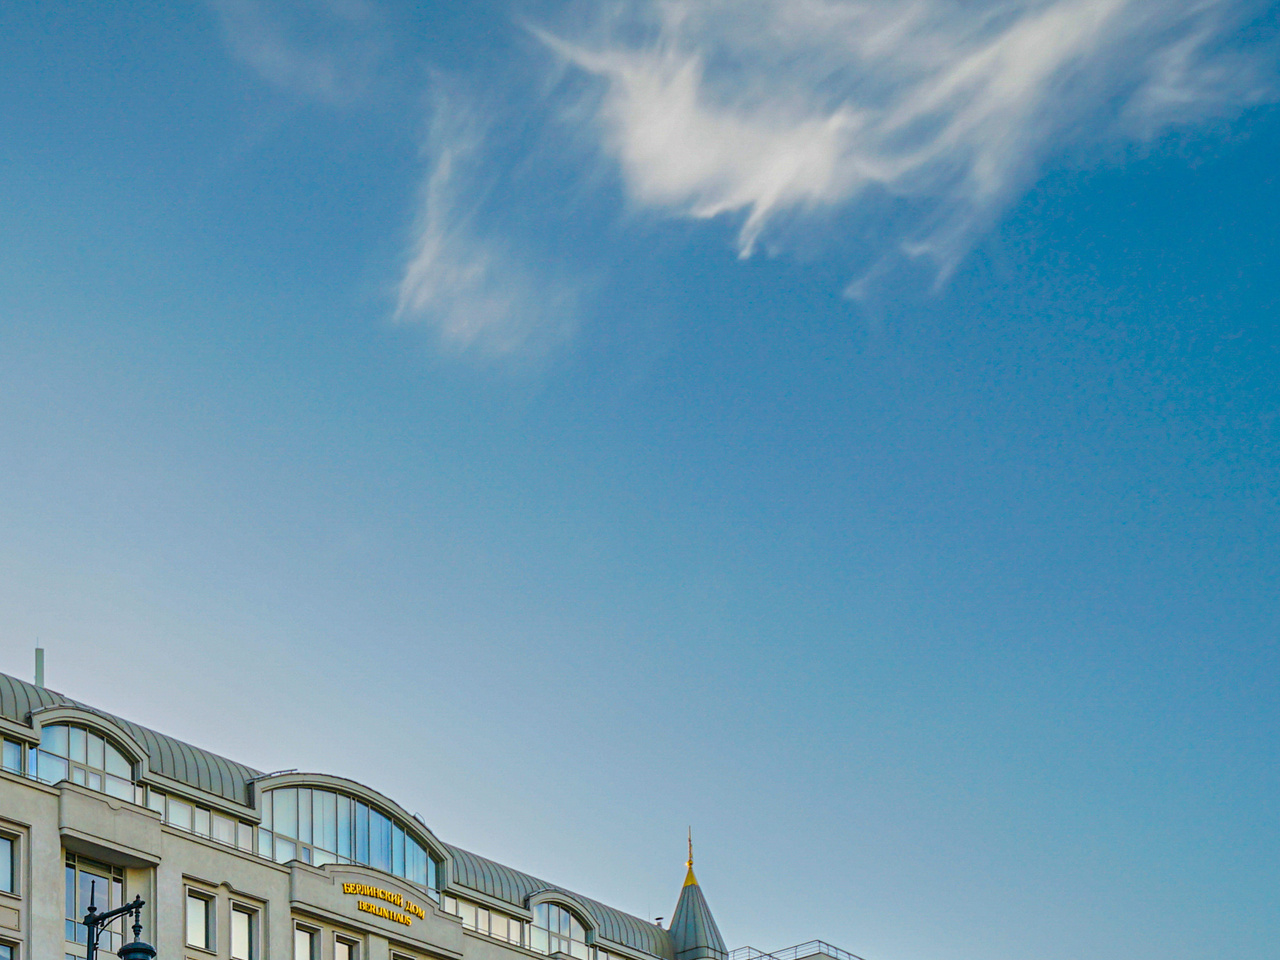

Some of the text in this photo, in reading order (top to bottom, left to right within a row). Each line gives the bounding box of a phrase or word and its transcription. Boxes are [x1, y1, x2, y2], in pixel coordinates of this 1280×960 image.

[342, 883, 426, 920] БЕРЛИНСКИЙ ДОМ
[390, 911, 412, 926] HAUS
